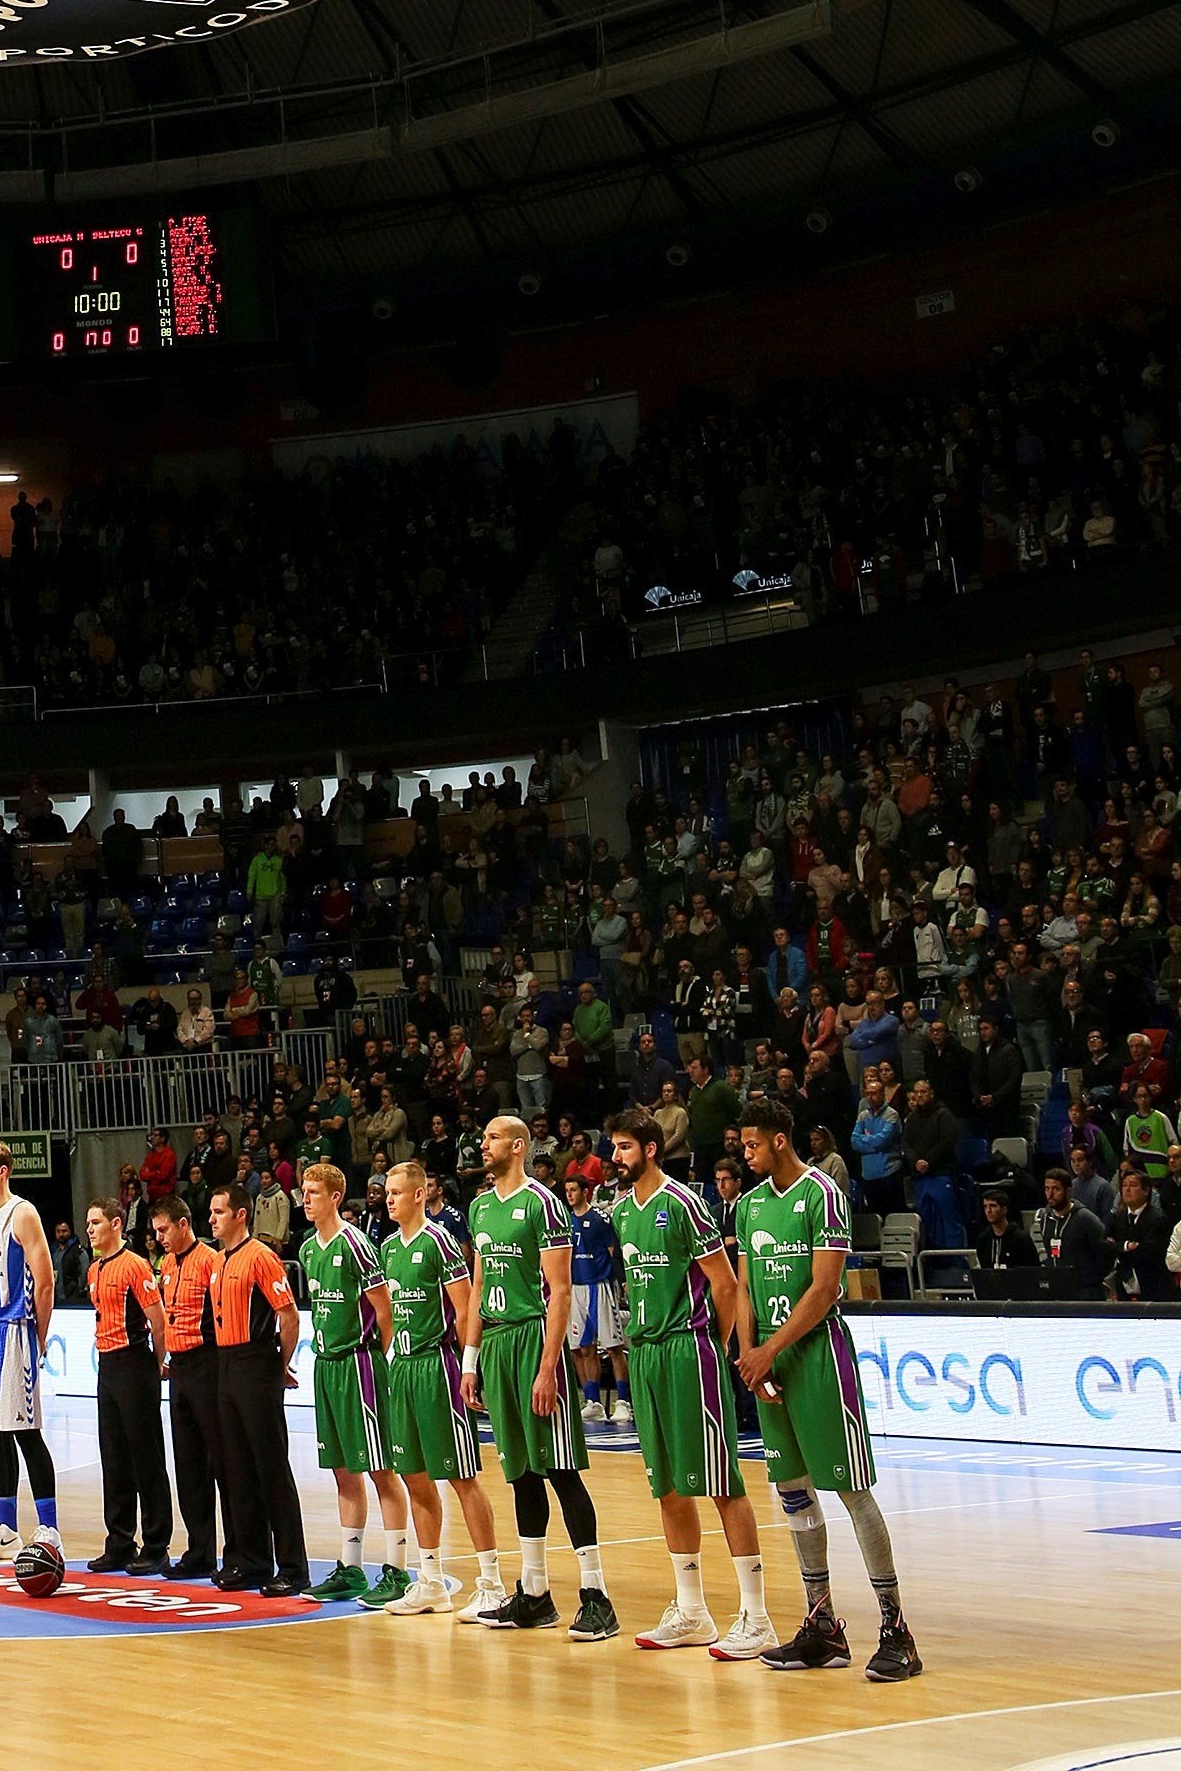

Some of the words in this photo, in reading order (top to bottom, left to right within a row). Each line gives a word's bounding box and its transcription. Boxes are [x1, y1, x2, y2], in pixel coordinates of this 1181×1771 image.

[32, 233, 73, 245] UNICAJA
[62, 249, 73, 269] 0
[126, 243, 138, 264] 0
[93, 266, 97, 281] 1
[74, 291, 121, 313] 10:00
[76, 318, 113, 328] MONDO
[53, 332, 64, 351] 0
[102, 330, 111, 345] 0
[129, 327, 139, 344] 0
[669, 589, 702, 604] Unicaja
[32, 1141, 43, 1155] DE
[575, 1232, 582, 1247] 7
[773, 1239, 809, 1255] Unicaja
[490, 1241, 523, 1255] Unicaja
[638, 1250, 670, 1265] Unicaja
[318, 1287, 345, 1301] Unicaja
[398, 1286, 427, 1300] Unicaja
[487, 1285, 507, 1312] 40
[767, 1295, 792, 1326] 23
[316, 1329, 325, 1354] 9
[396, 1329, 412, 1356] 10
[857, 1335, 1028, 1416] desa
